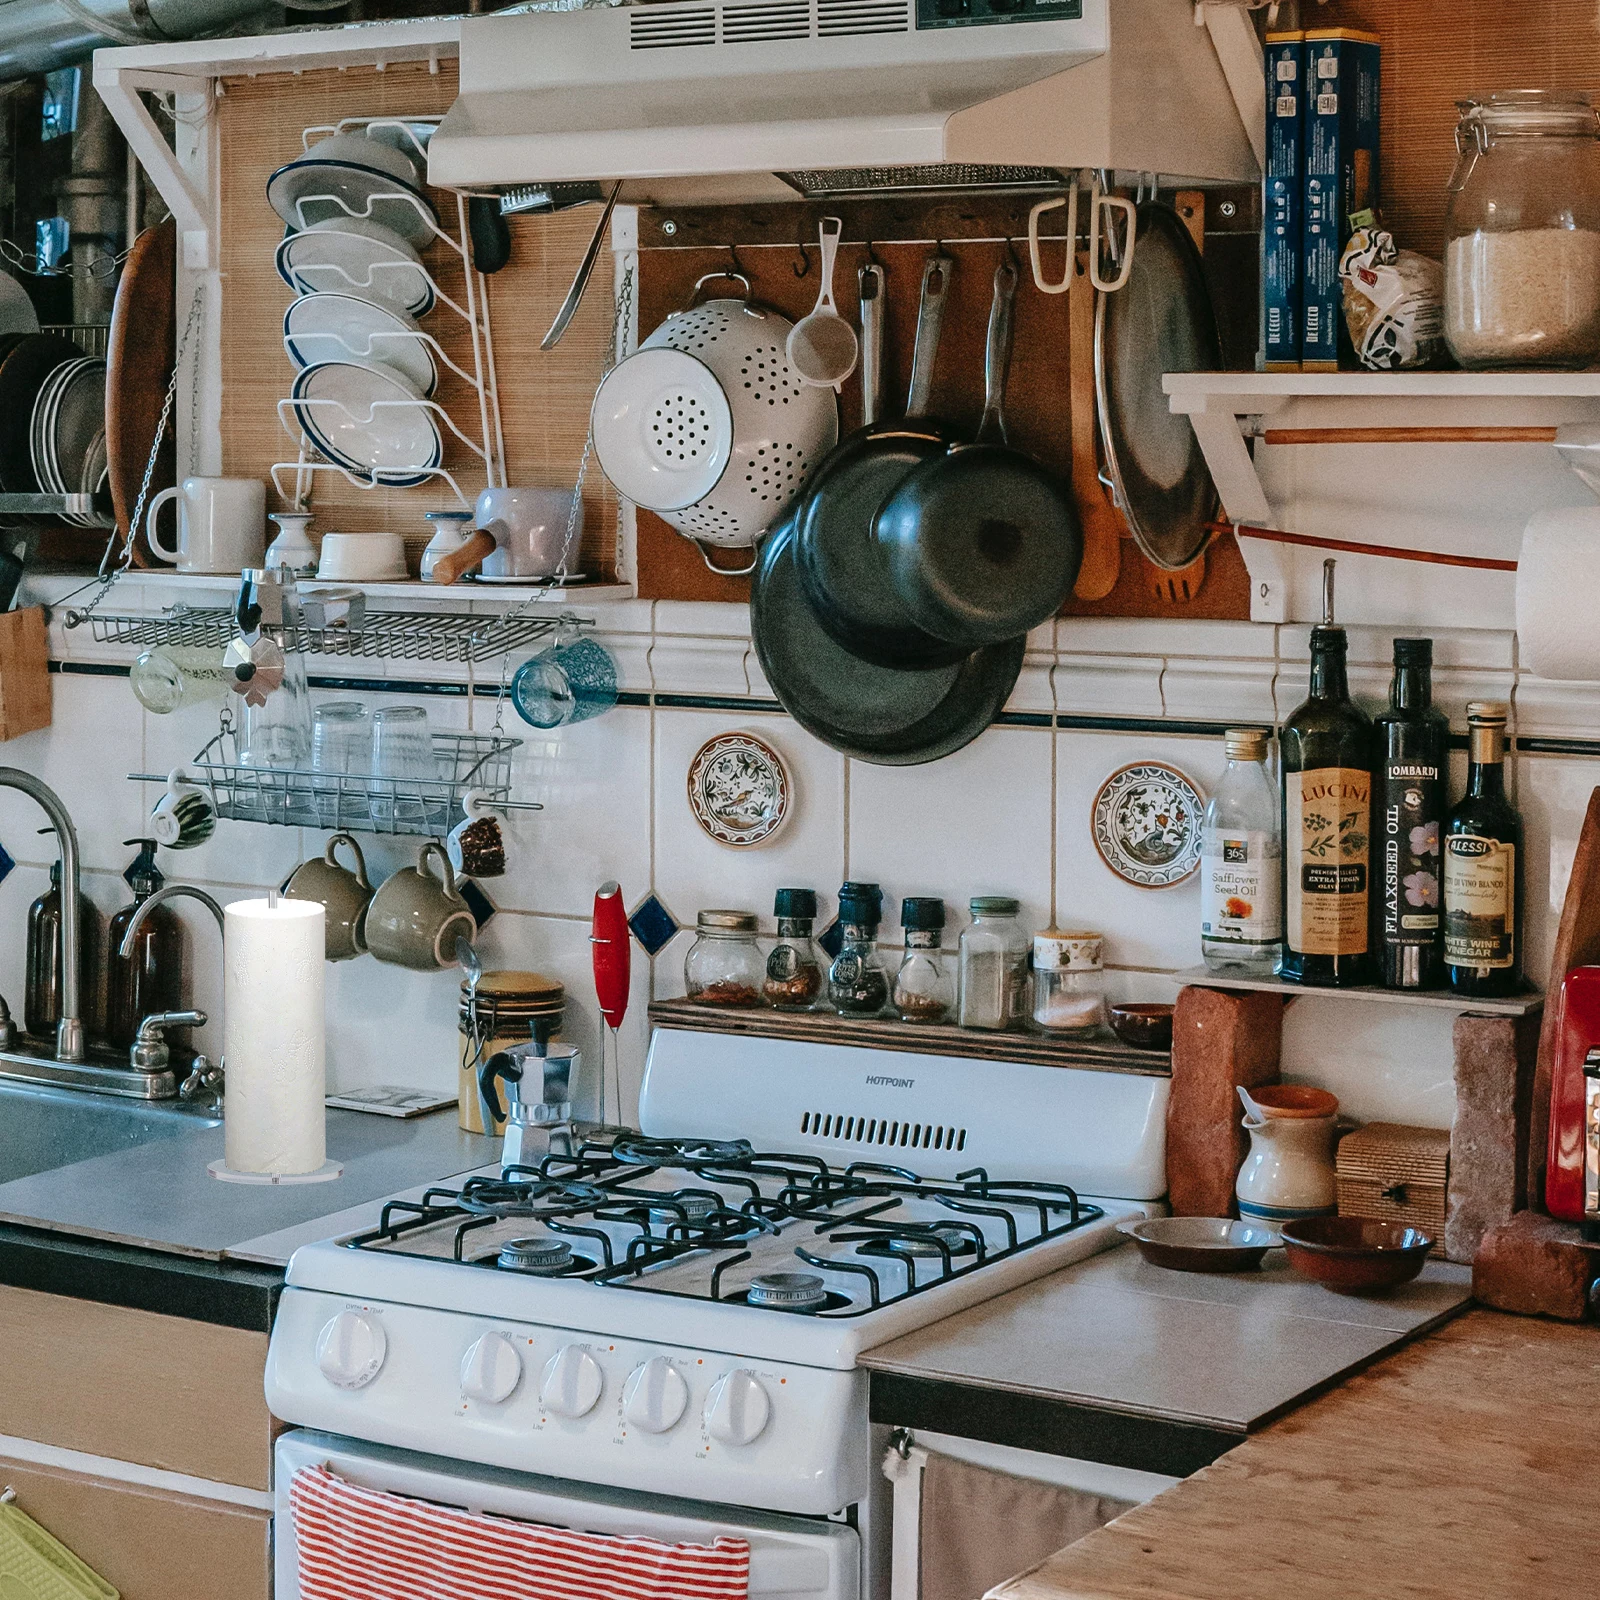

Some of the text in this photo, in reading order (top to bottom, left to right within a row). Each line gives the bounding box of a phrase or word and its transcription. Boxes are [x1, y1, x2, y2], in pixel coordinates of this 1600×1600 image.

[1387, 765, 1438, 781] LOMBARDI
[1450, 840, 1487, 853] ALESSI
[1226, 847, 1245, 859] 365
[1385, 804, 1399, 934] FLAXSEED OIL
[1212, 872, 1259, 885] Safflower
[1308, 875, 1335, 883] EXTRA
[1214, 884, 1257, 896] Seed Oil
[1470, 939, 1500, 949] WINE
[1447, 945, 1491, 957] VINEGAR
[866, 1075, 915, 1089] HOTPOINT
